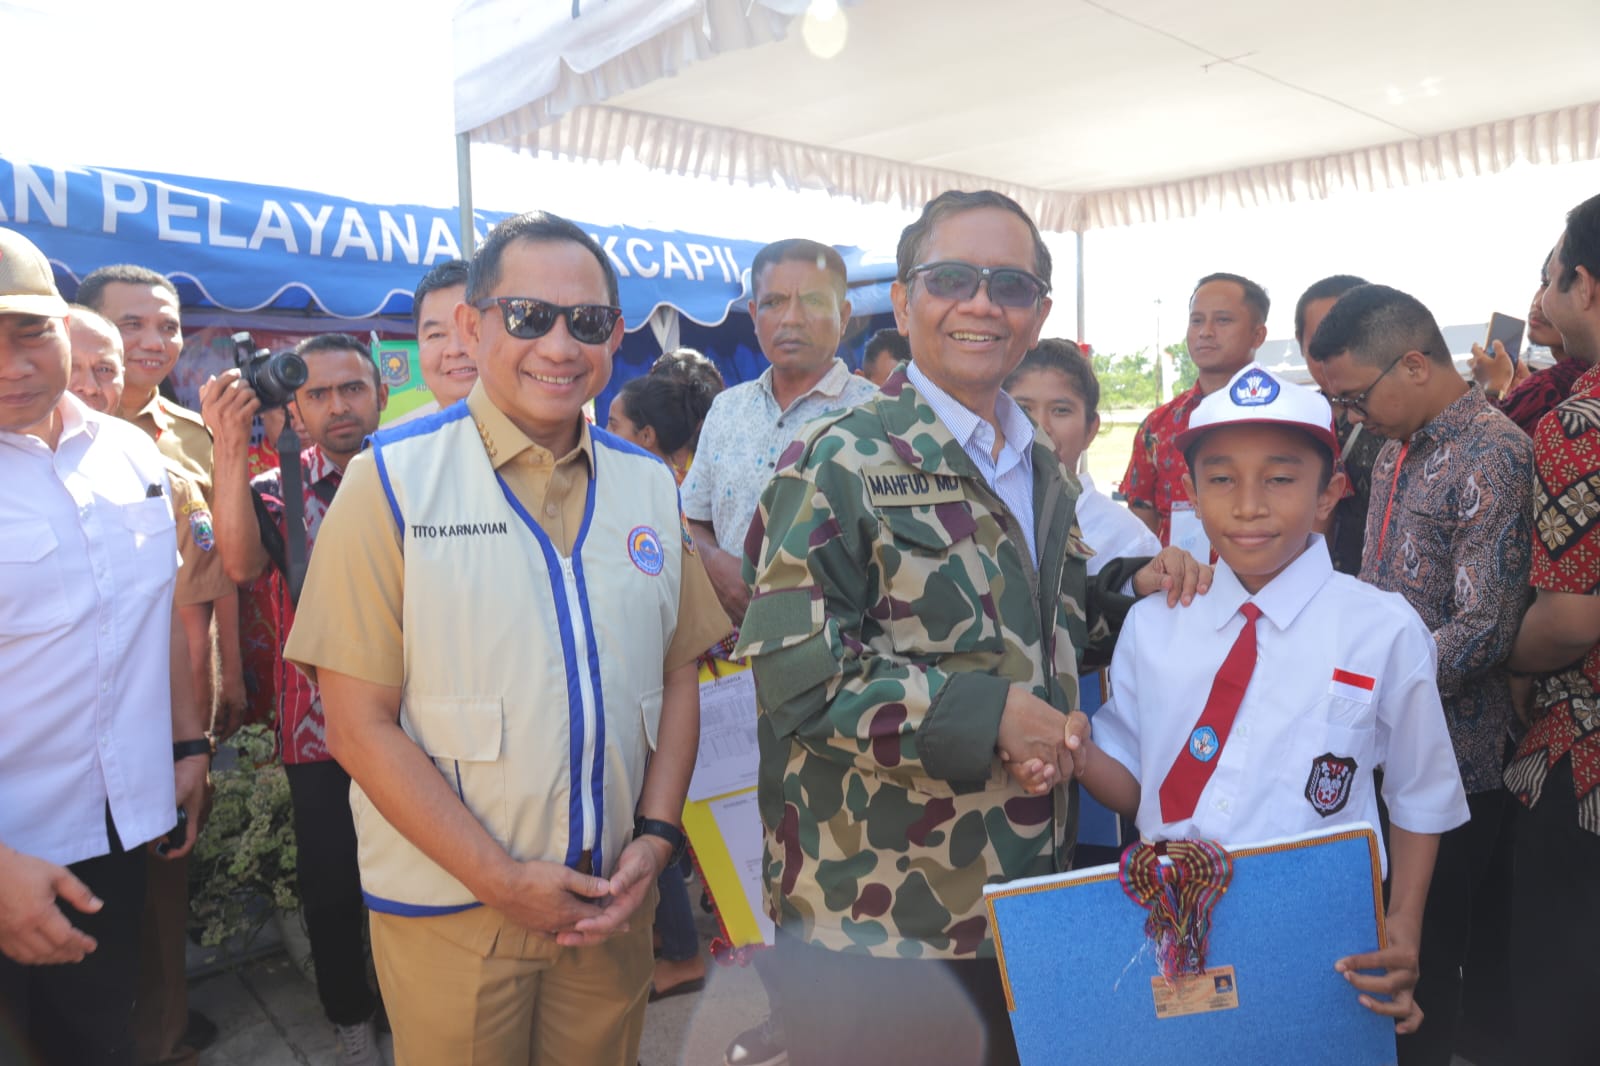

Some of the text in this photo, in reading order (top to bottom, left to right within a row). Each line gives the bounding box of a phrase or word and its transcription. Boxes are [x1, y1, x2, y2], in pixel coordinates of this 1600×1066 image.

[0, 161, 68, 228] N
[868, 473, 959, 496] MAHFUD MD
[411, 521, 508, 539] TITO KARNAVIAN
